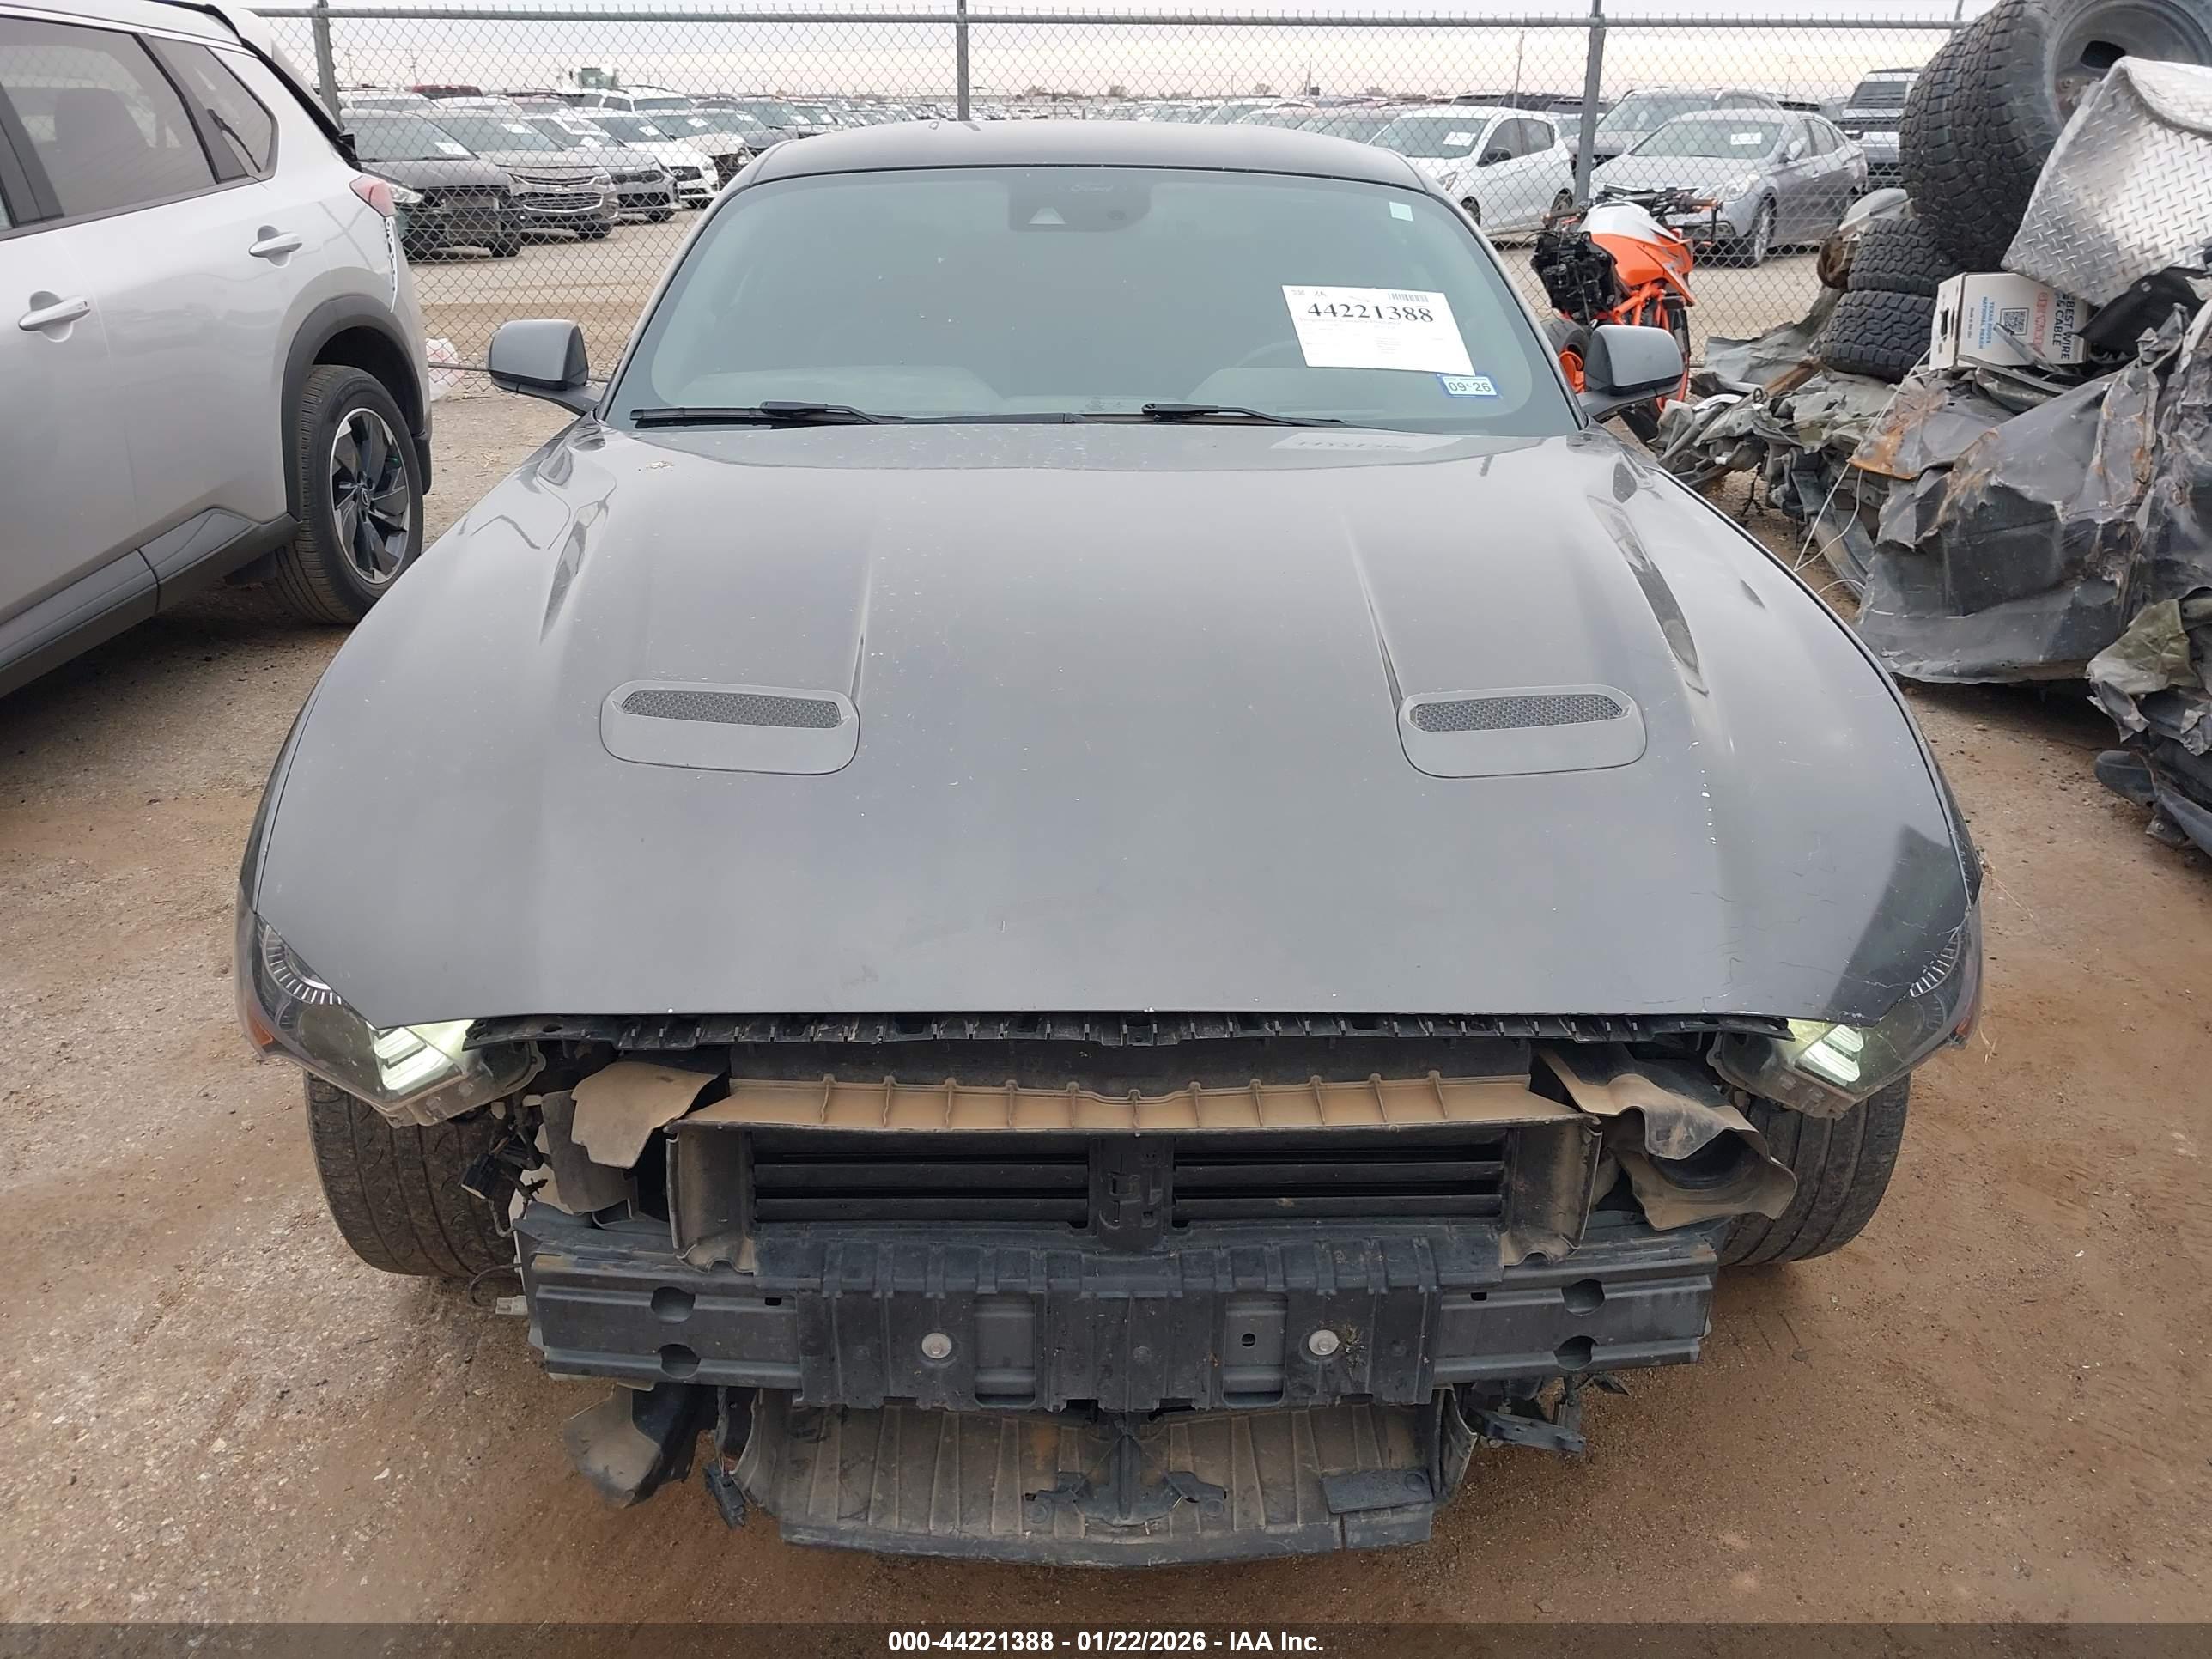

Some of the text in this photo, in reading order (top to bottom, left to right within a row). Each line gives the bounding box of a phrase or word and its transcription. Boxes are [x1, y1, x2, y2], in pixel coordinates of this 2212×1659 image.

[1307, 302, 1434, 323] 44221388
[2052, 310, 2064, 346] CABLE
[2061, 301, 2075, 360] BEST WIRE
[1448, 382, 1492, 392] 09 26
